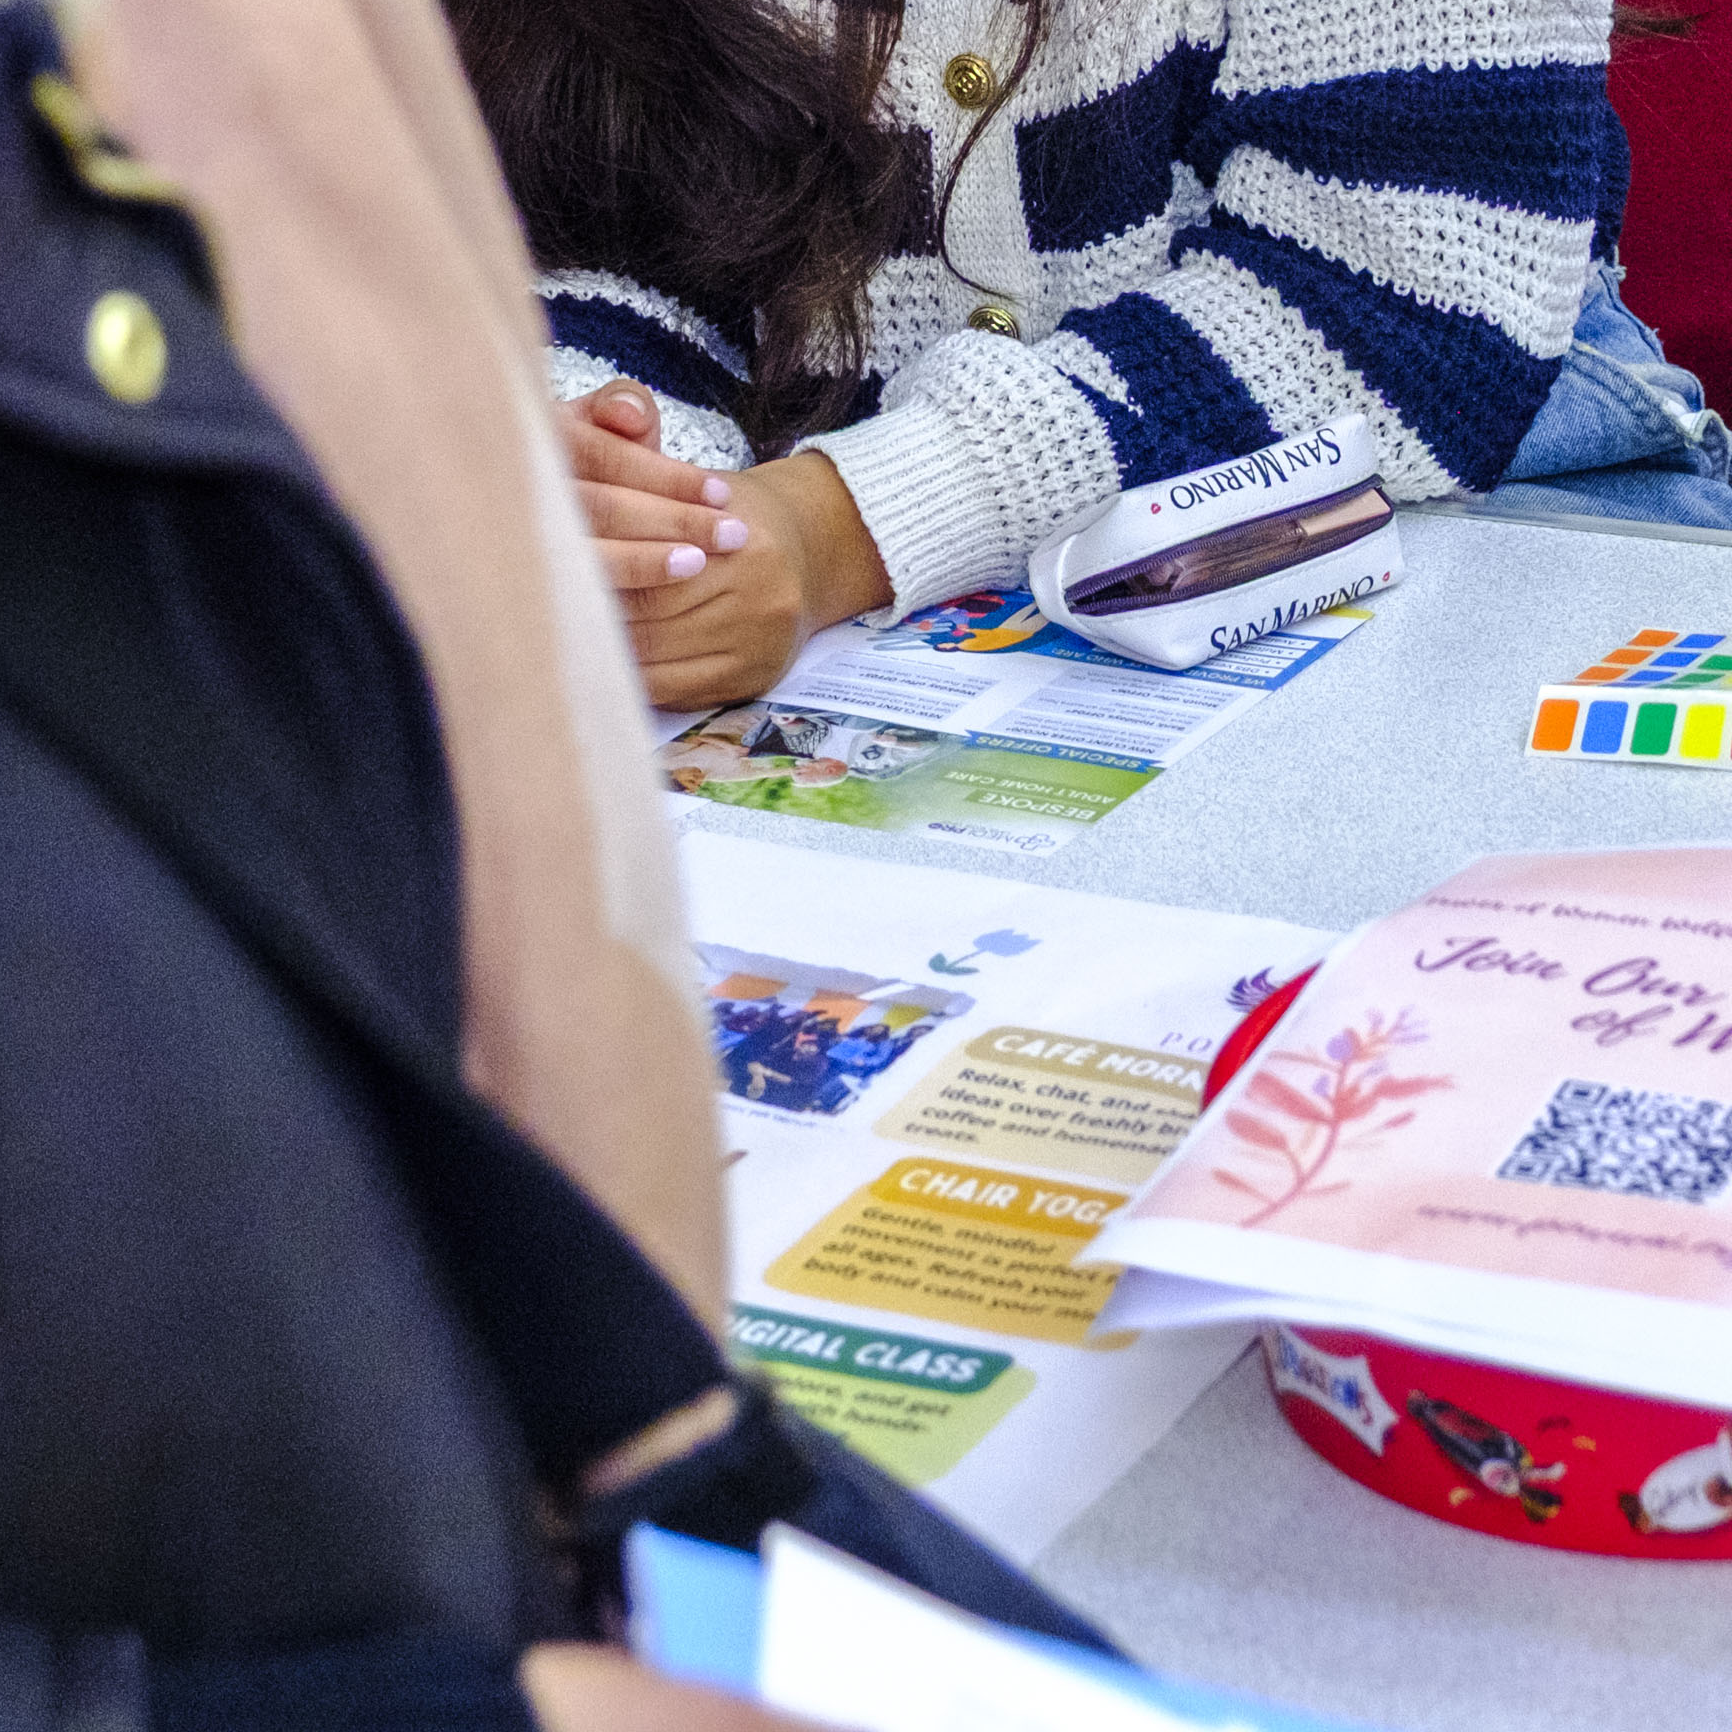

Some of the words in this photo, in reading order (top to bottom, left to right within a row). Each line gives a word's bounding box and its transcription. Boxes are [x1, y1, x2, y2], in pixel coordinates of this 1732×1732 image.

[1170, 448, 1290, 510] MARINO
[1271, 575, 1375, 632] MARINO
[972, 734, 1056, 755] OFFERS
[1051, 746, 1145, 769] SPECIAL
[941, 769, 999, 786] CARE
[993, 777, 1056, 795] HOME
[1051, 786, 1118, 805] ADULT
[974, 791, 1099, 820] BESPOKE
[1414, 935, 1567, 982] Join
[1583, 955, 1728, 1008] Our
[1570, 1003, 1675, 1048] of
[993, 1033, 1098, 1066] CAFÉ
[957, 1067, 1027, 1094] Relax,
[1035, 1082, 1093, 1106] chat,
[1101, 1096, 1152, 1112] and
[921, 1105, 997, 1129] coffee
[939, 1085, 1002, 1110] ideas
[1069, 1109, 1155, 1137] freshly
[898, 1168, 1019, 1210] CHAIR
[1027, 1190, 1111, 1225] YOG
[853, 1341, 984, 1384] CLASS
